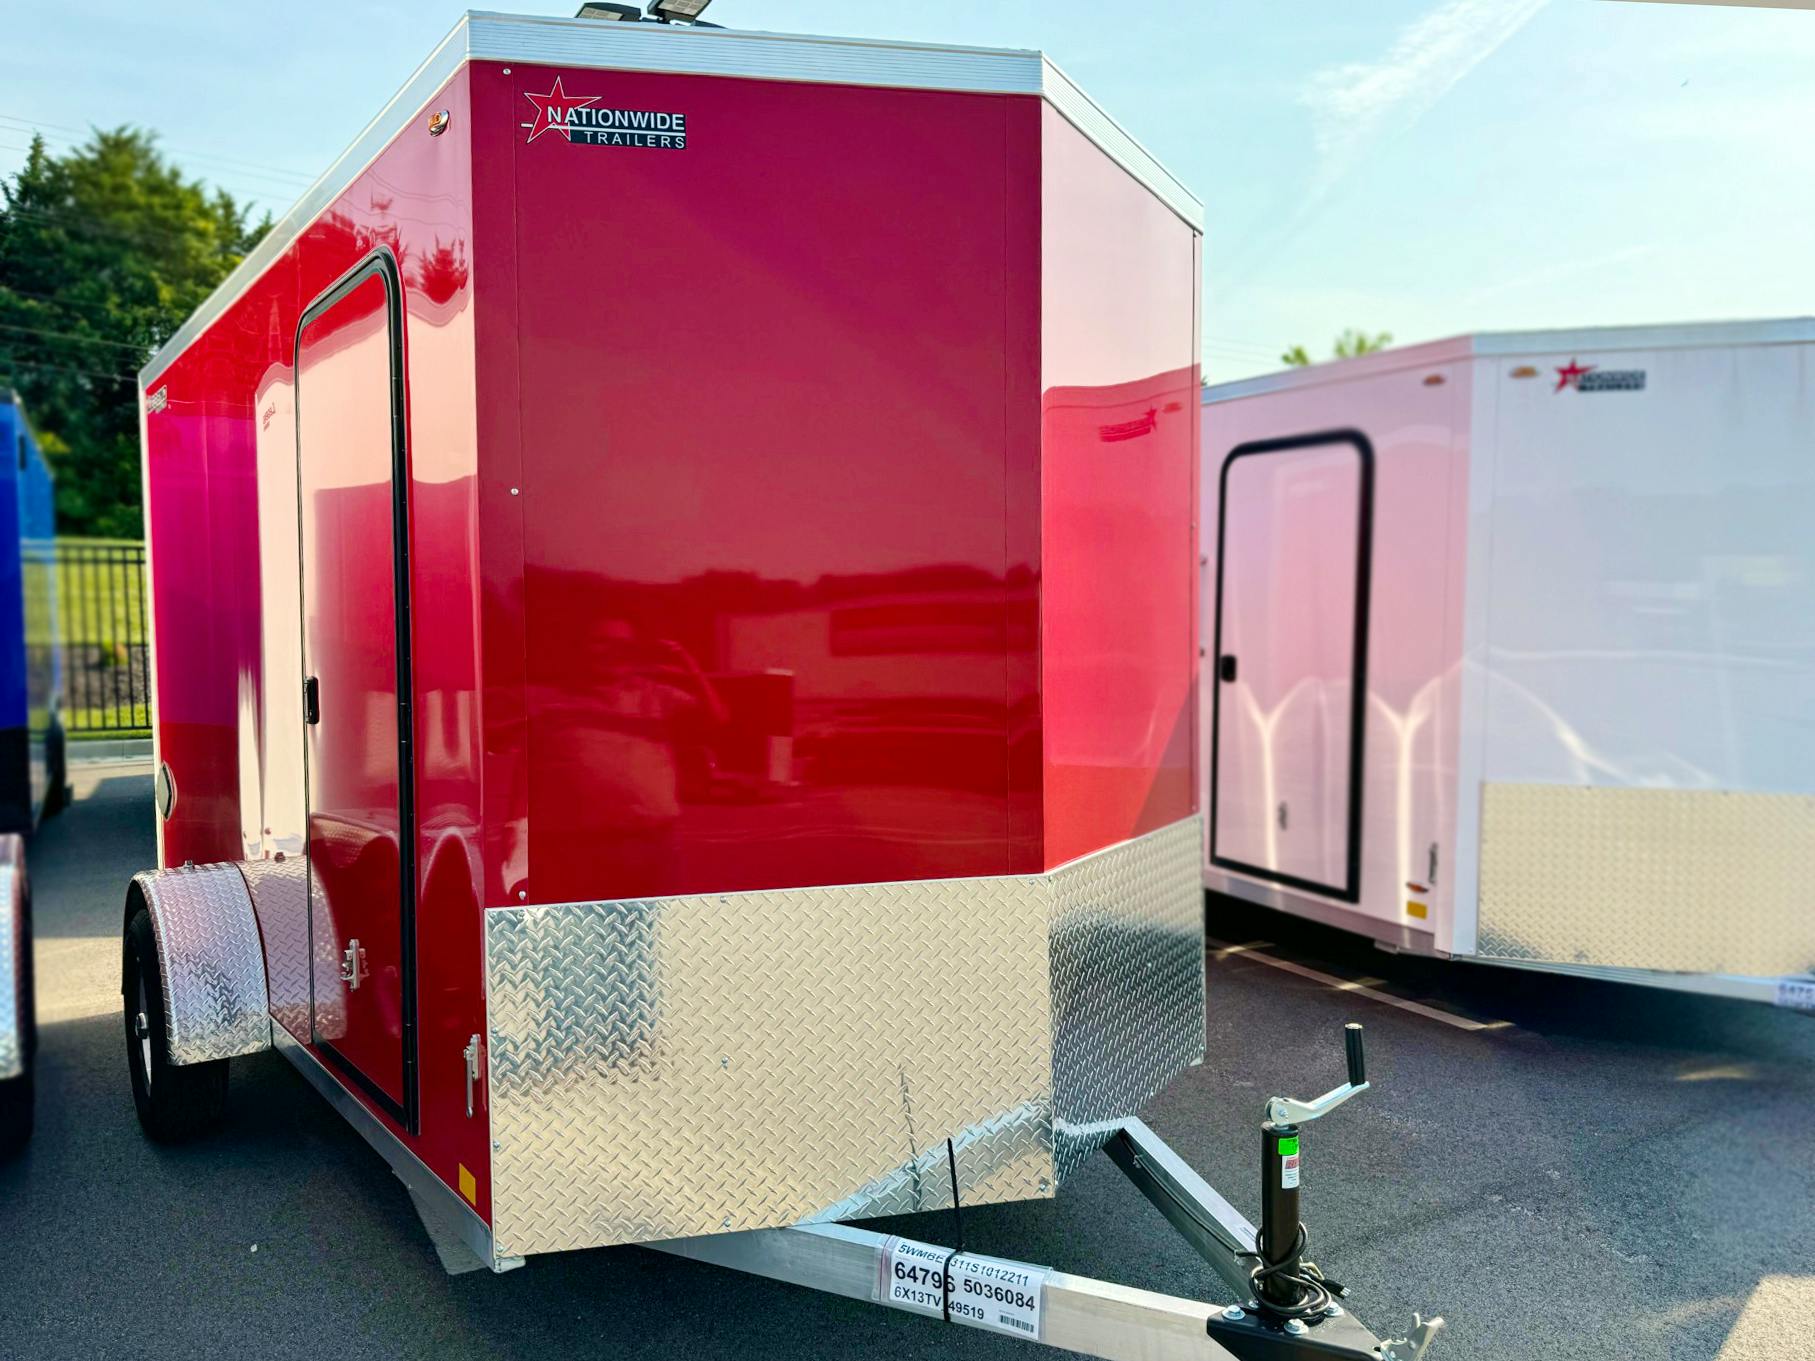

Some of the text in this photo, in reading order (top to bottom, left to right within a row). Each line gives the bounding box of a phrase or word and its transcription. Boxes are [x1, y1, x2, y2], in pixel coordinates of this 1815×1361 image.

[547, 106, 685, 130] NATIONWIDE
[584, 131, 685, 149] TRAILERS
[898, 1244, 1029, 1286] 5WMBE311S1012211
[895, 1261, 1035, 1311] 64796 5036084
